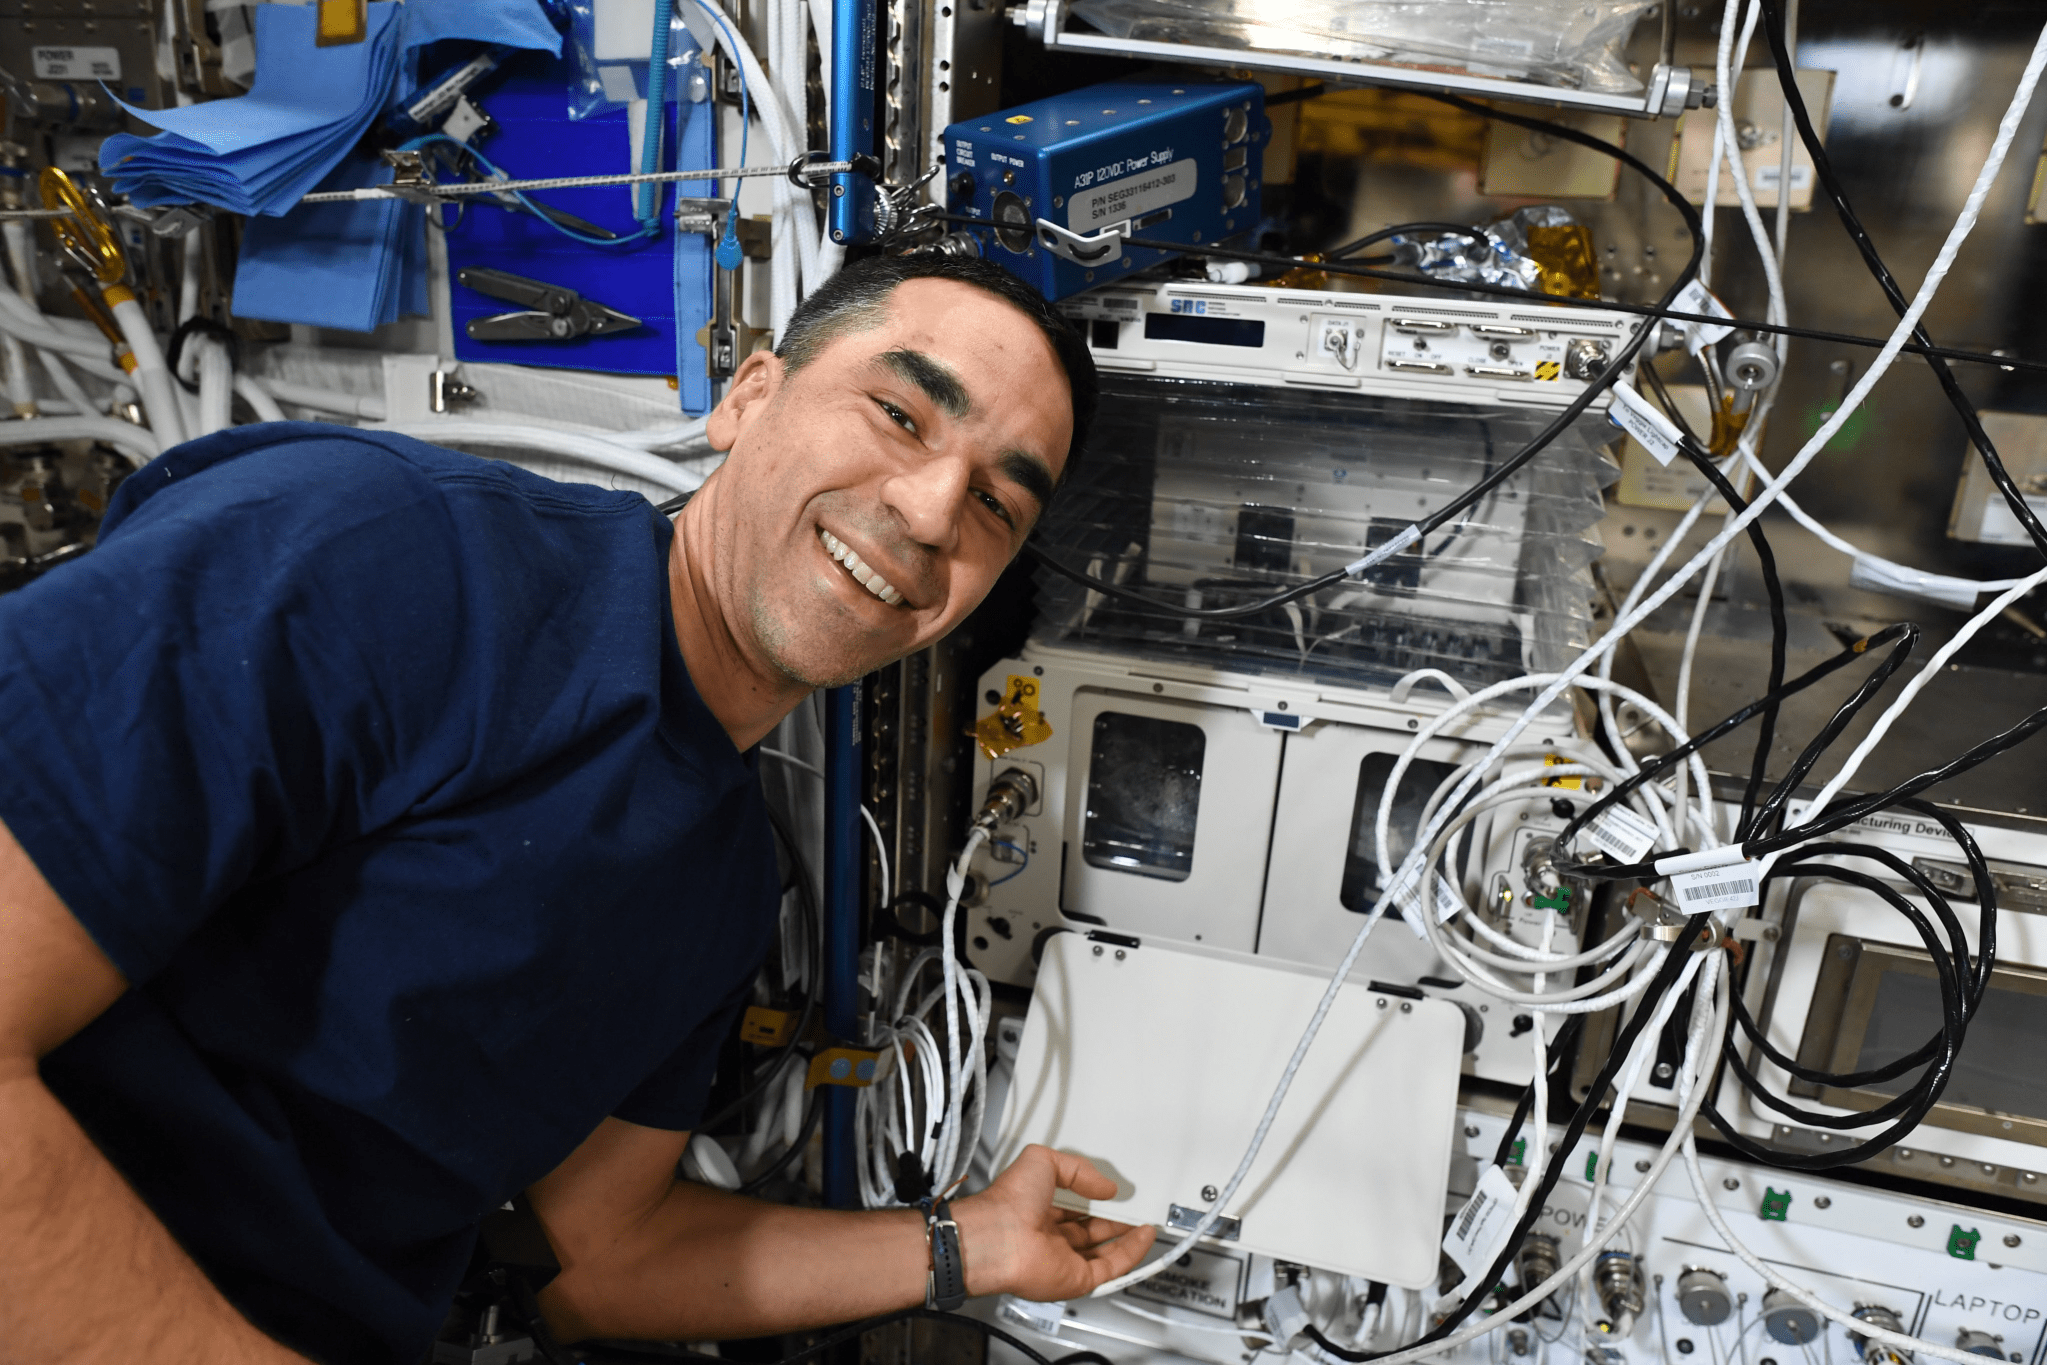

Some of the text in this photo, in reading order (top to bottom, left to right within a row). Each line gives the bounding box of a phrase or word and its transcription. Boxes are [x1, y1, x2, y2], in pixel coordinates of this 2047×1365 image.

[1074, 146, 1174, 189] A31P 120VDC Power Supply
[1092, 196, 1106, 208] P/N
[1092, 208, 1106, 220] S/N
[1628, 419, 1648, 440] POWER
[1690, 870, 1721, 881] S/N 0002
[1935, 1288, 2040, 1323] LAPTOP
